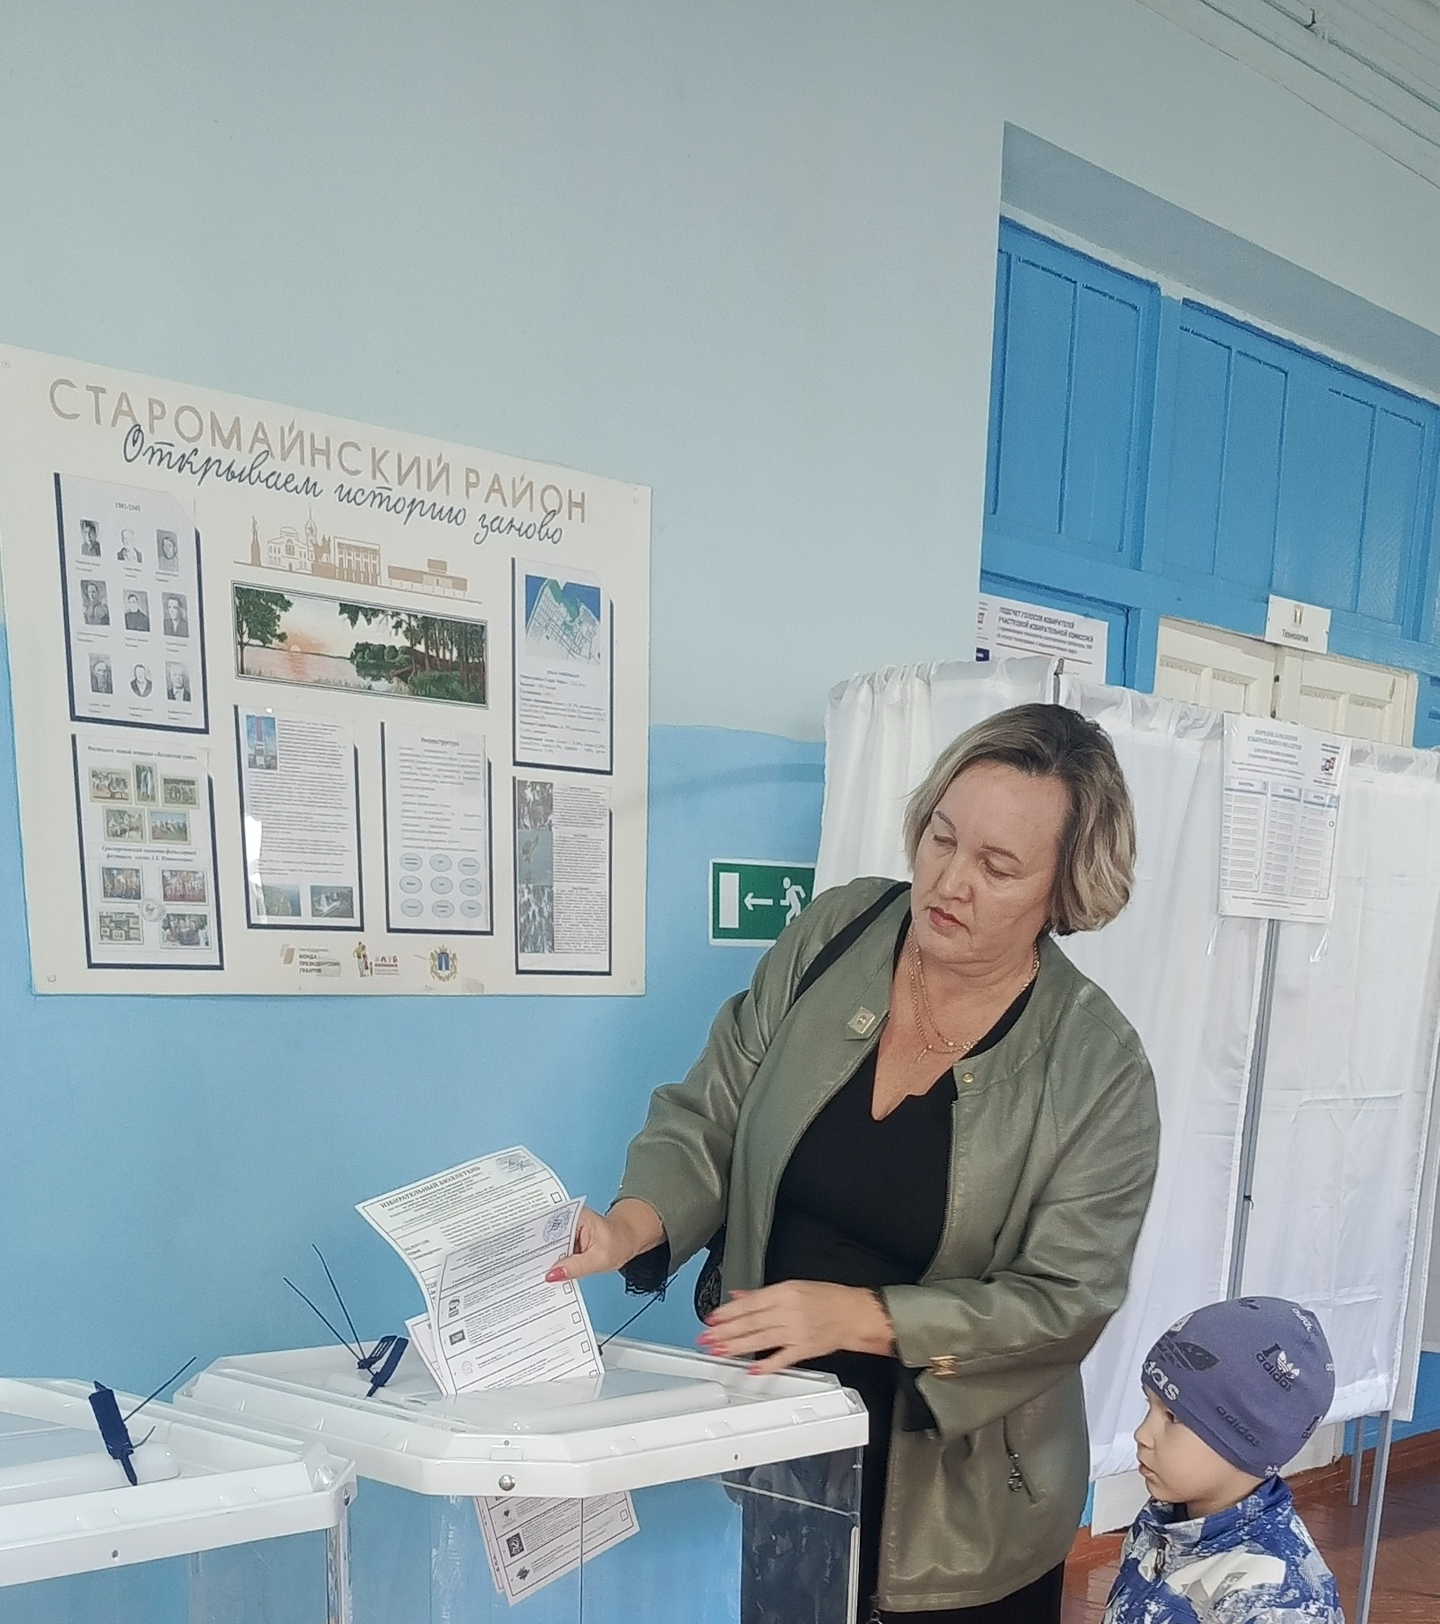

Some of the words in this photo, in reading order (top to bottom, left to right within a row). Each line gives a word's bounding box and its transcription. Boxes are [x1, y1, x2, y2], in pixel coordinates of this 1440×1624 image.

[49, 378, 450, 496] СТАРОМАЙНСКИЙ
[464, 466, 586, 523] РАЙОН
[123, 423, 323, 498] Открываем
[334, 482, 467, 526] историю
[474, 509, 563, 545] заново
[1256, 1352, 1293, 1392] adidas
[1215, 1405, 1262, 1448] adidas
